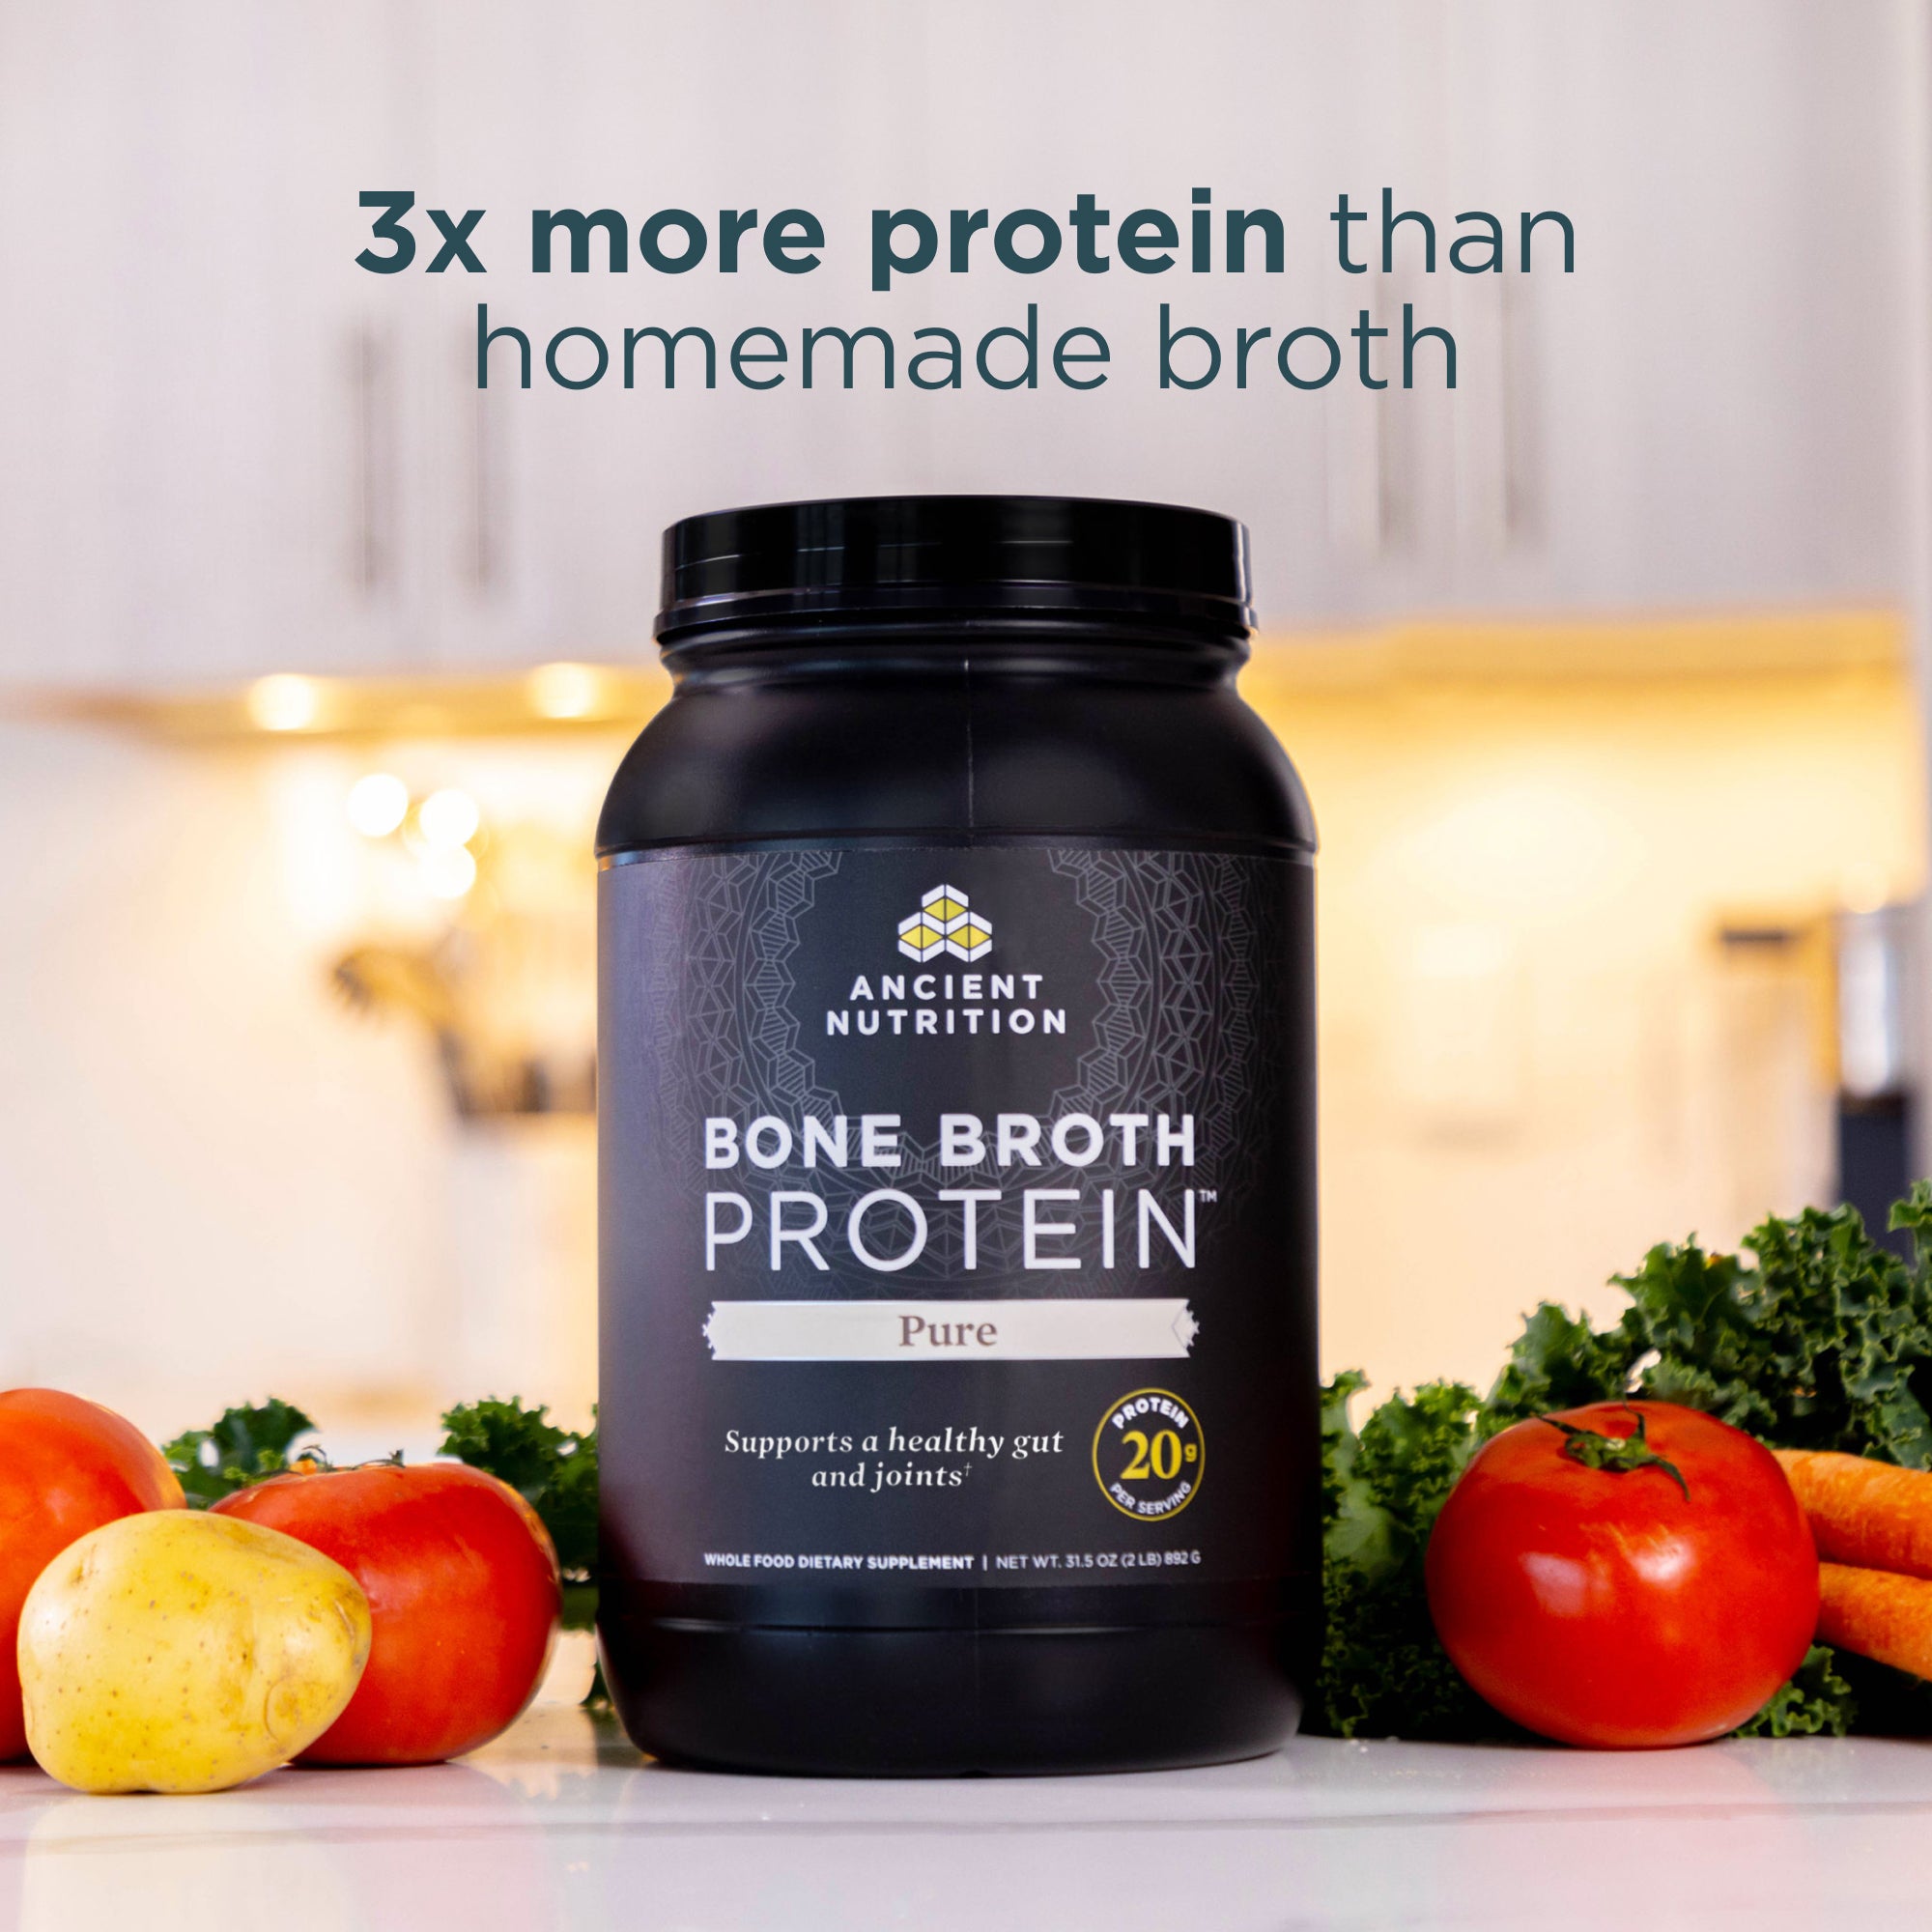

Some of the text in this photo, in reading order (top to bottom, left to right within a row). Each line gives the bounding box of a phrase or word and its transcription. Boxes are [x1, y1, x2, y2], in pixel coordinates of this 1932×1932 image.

[849, 974, 1043, 1001] ANCIENT
[826, 1008, 1066, 1036] NUTRITION
[704, 1112, 1195, 1170] BONE BROTH
[897, 1315, 998, 1348] Pure
[1111, 1397, 1190, 1430] PROTEIN
[724, 1426, 1065, 1460] Supports a healthy gut
[811, 1462, 866, 1488] and
[1110, 1480, 1192, 1515] PER SERVING
[703, 1550, 1202, 1571] WHOLE FOOD DIETARY SUPPLEMENT NET WT. 31.5 OZ (2 LB) 892 G
